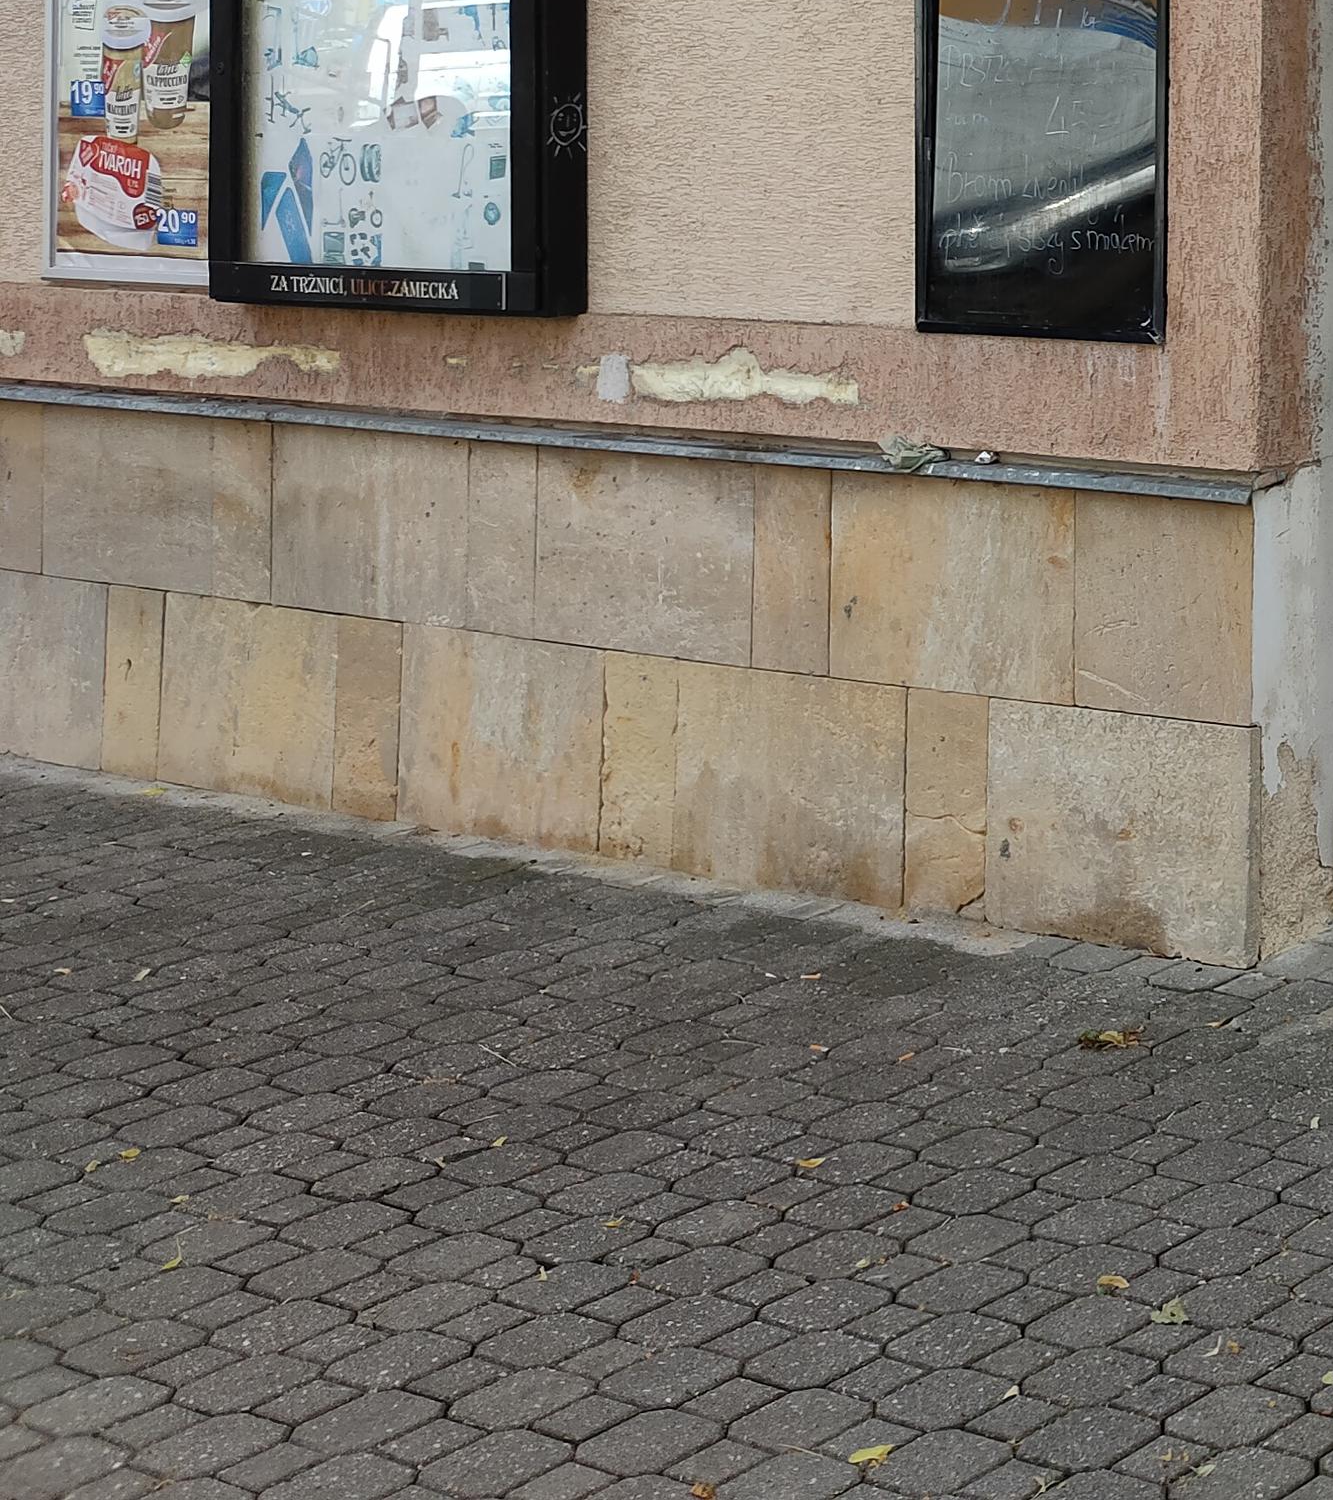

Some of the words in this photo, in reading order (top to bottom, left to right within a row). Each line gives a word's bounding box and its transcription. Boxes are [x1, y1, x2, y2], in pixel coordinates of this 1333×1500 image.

[98, 150, 143, 180] TVAROH
[157, 208, 180, 233] 20
[181, 211, 197, 224] 90
[270, 275, 288, 292] ZA
